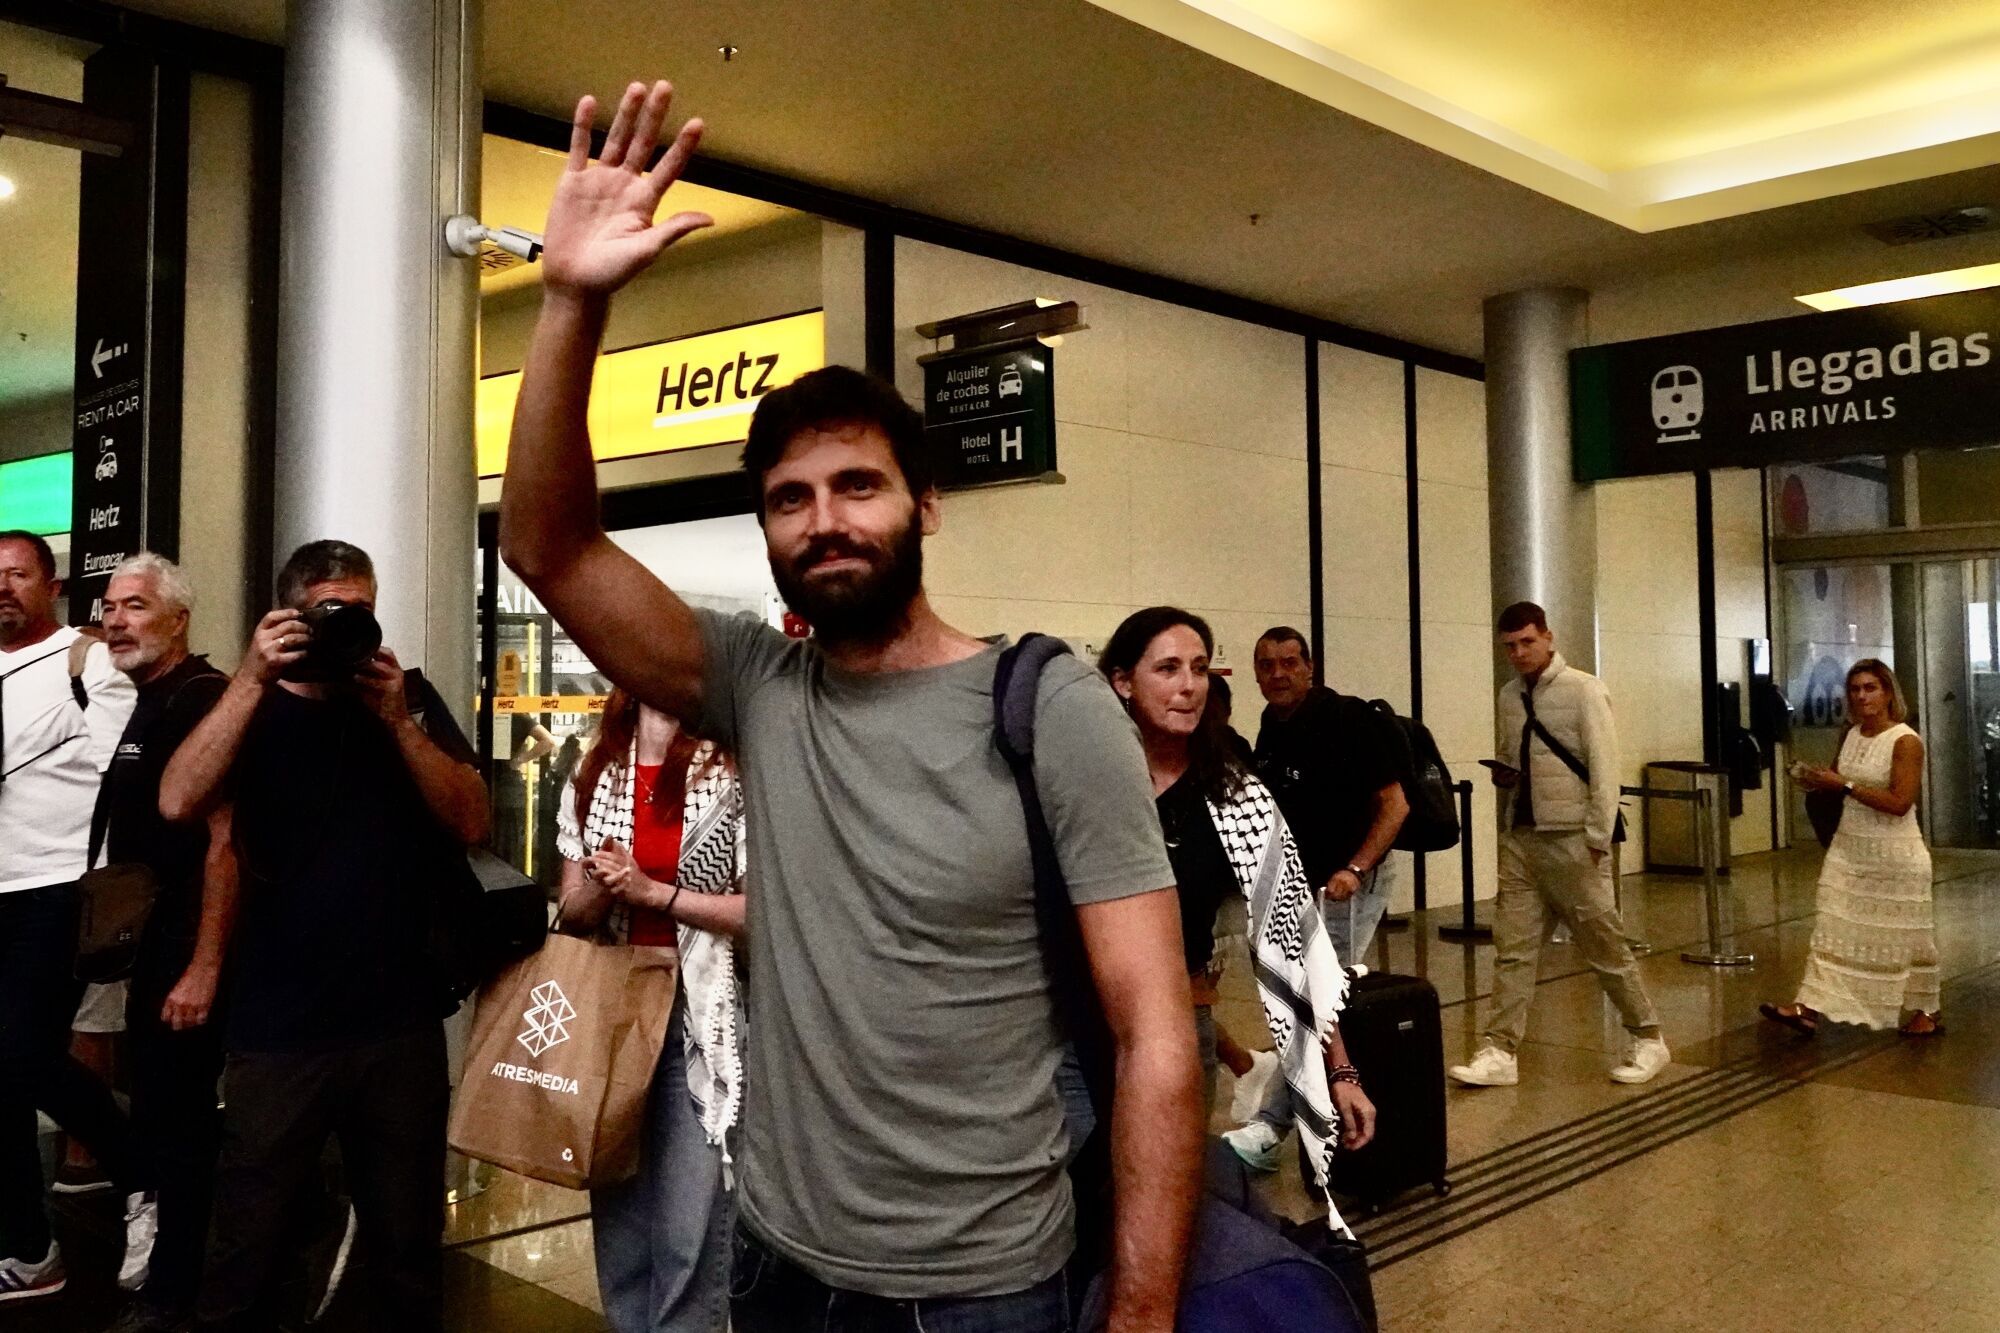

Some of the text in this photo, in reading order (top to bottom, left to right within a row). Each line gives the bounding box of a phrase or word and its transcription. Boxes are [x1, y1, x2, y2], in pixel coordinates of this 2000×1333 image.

[1746, 330, 1992, 396] Llegadas
[656, 351, 780, 414] Hertz
[946, 365, 990, 384] Alquiler
[936, 383, 990, 403] de coches
[78, 406, 106, 430] RENT
[106, 404, 115, 421] A
[116, 395, 140, 417] CAR
[949, 403, 968, 414] RENT
[976, 399, 990, 410] CAR
[1749, 396, 1898, 434] ARRIVALS
[961, 432, 991, 450] Hotel
[1000, 425, 1023, 463] H
[967, 454, 990, 465] HOTEL
[89, 503, 120, 531] Hertz
[84, 552, 125, 571] Europcar
[497, 698, 515, 709] Hertz
[541, 698, 560, 709] Hertz
[490, 1061, 579, 1095] ATRESMEDIA
